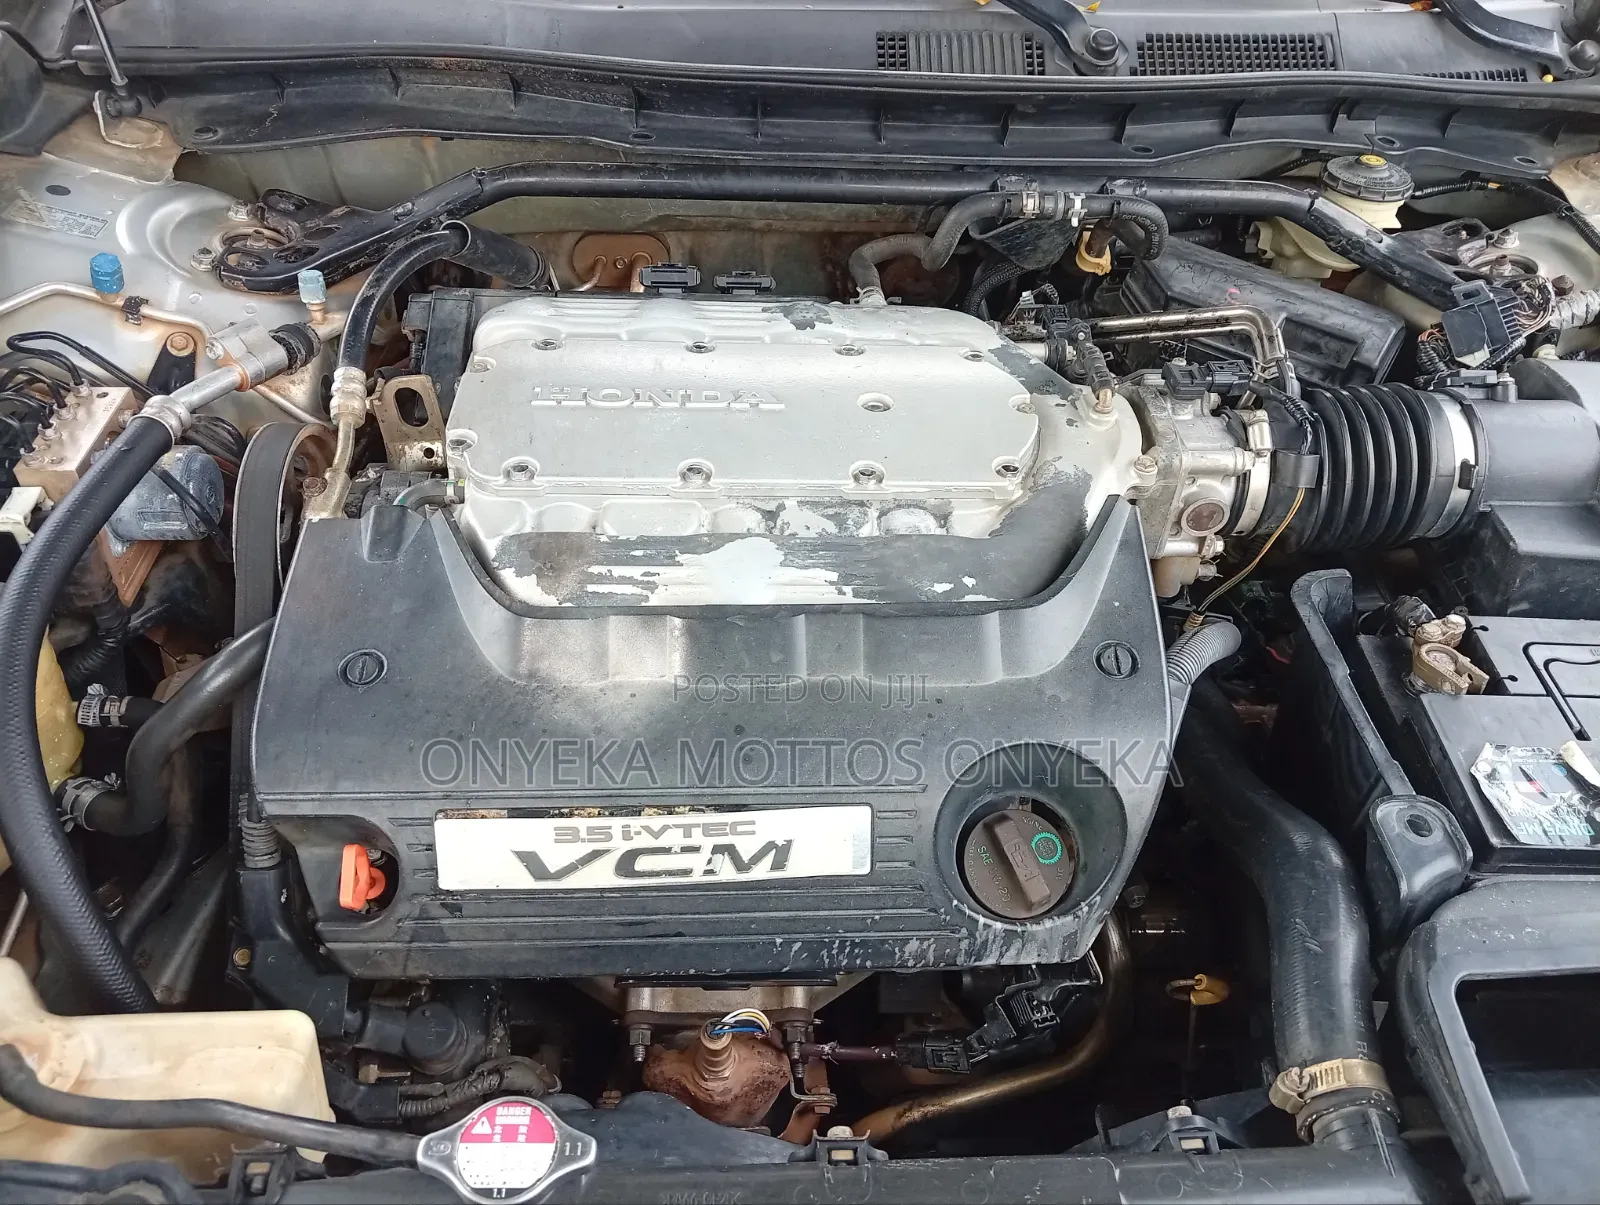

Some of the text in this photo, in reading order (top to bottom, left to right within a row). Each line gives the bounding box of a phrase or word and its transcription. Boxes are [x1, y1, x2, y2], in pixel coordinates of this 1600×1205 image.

[531, 386, 786, 408] HONDA
[554, 820, 756, 844] 3.5 i-VTEC
[511, 839, 795, 882] VCM
[977, 845, 994, 866] SAE
[496, 1106, 532, 1116] DANGER
[564, 1142, 582, 1156] 1.1
[492, 1188, 506, 1198] 1.1
